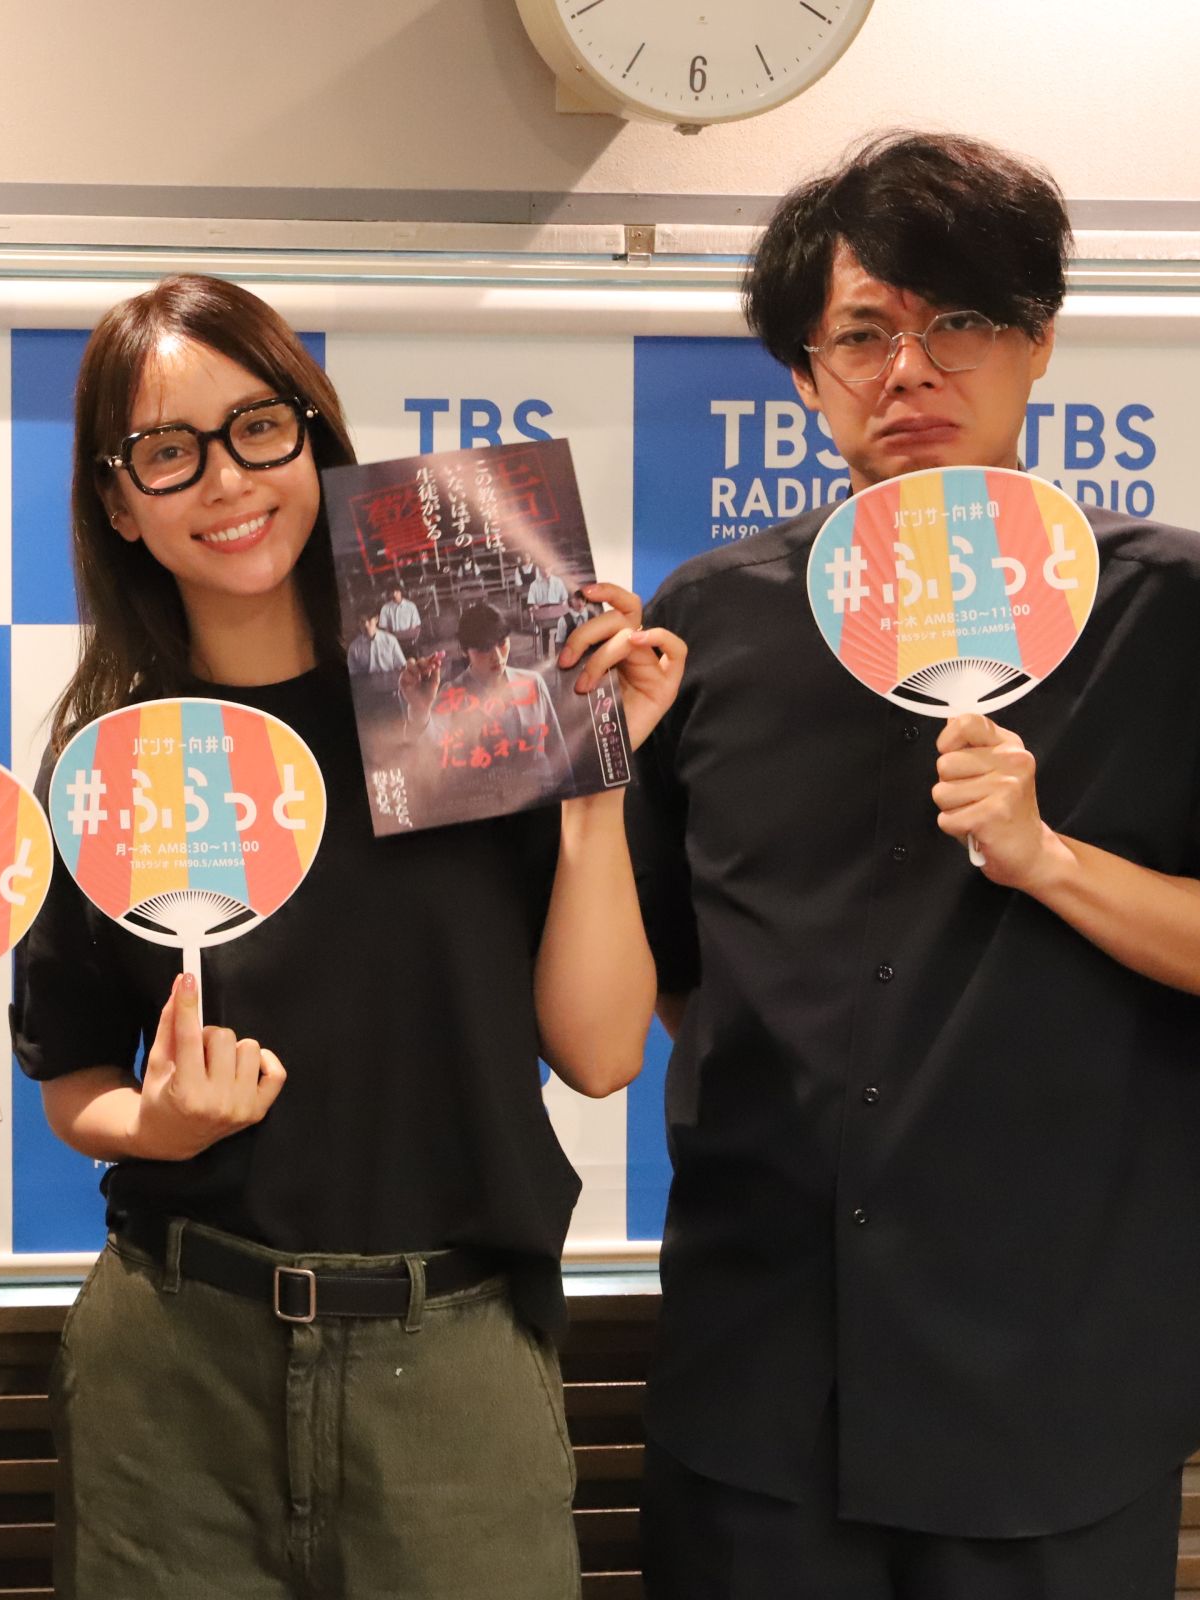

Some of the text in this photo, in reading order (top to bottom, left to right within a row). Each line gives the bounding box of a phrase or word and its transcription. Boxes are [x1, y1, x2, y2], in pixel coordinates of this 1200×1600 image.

[689, 55, 707, 93] 6
[1025, 403, 1156, 471] TBS
[66, 764, 307, 836] #ふらっと
